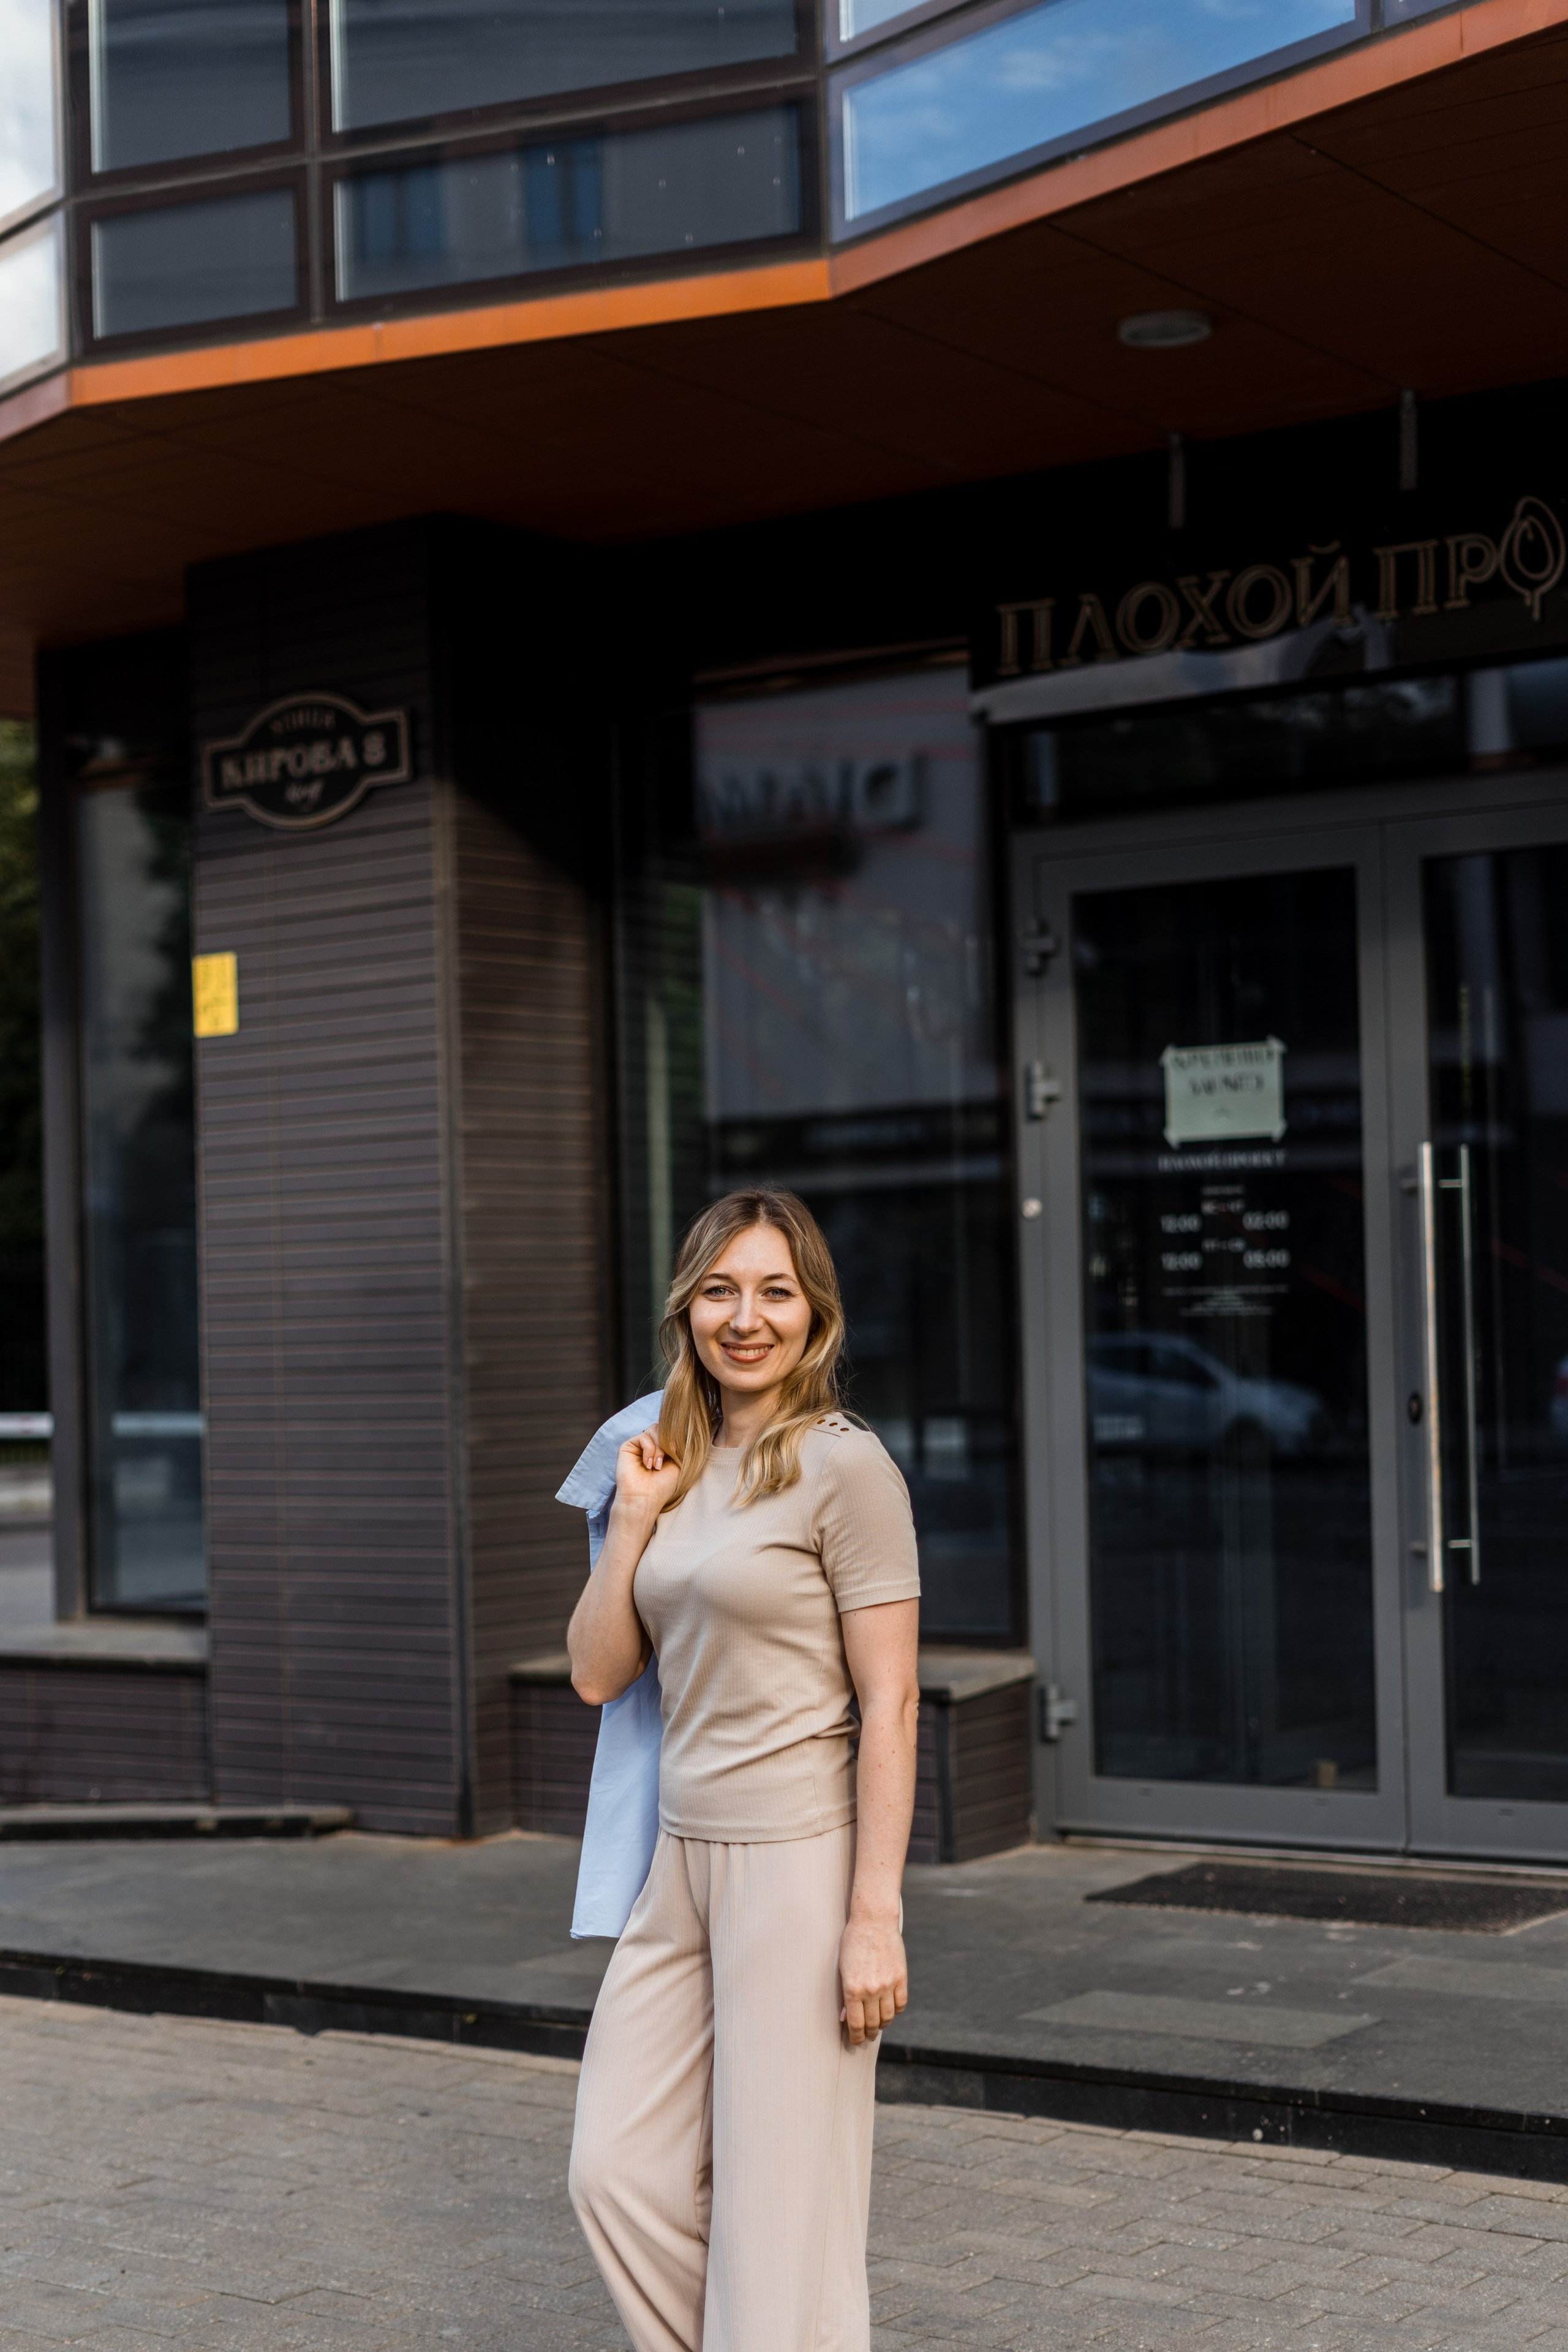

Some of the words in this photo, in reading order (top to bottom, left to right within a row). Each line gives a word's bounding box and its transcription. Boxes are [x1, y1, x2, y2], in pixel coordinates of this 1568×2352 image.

[995, 539, 1356, 676] ПЛОХОЙ
[222, 736, 357, 789] КИРОВА
[364, 732, 386, 765] 8
